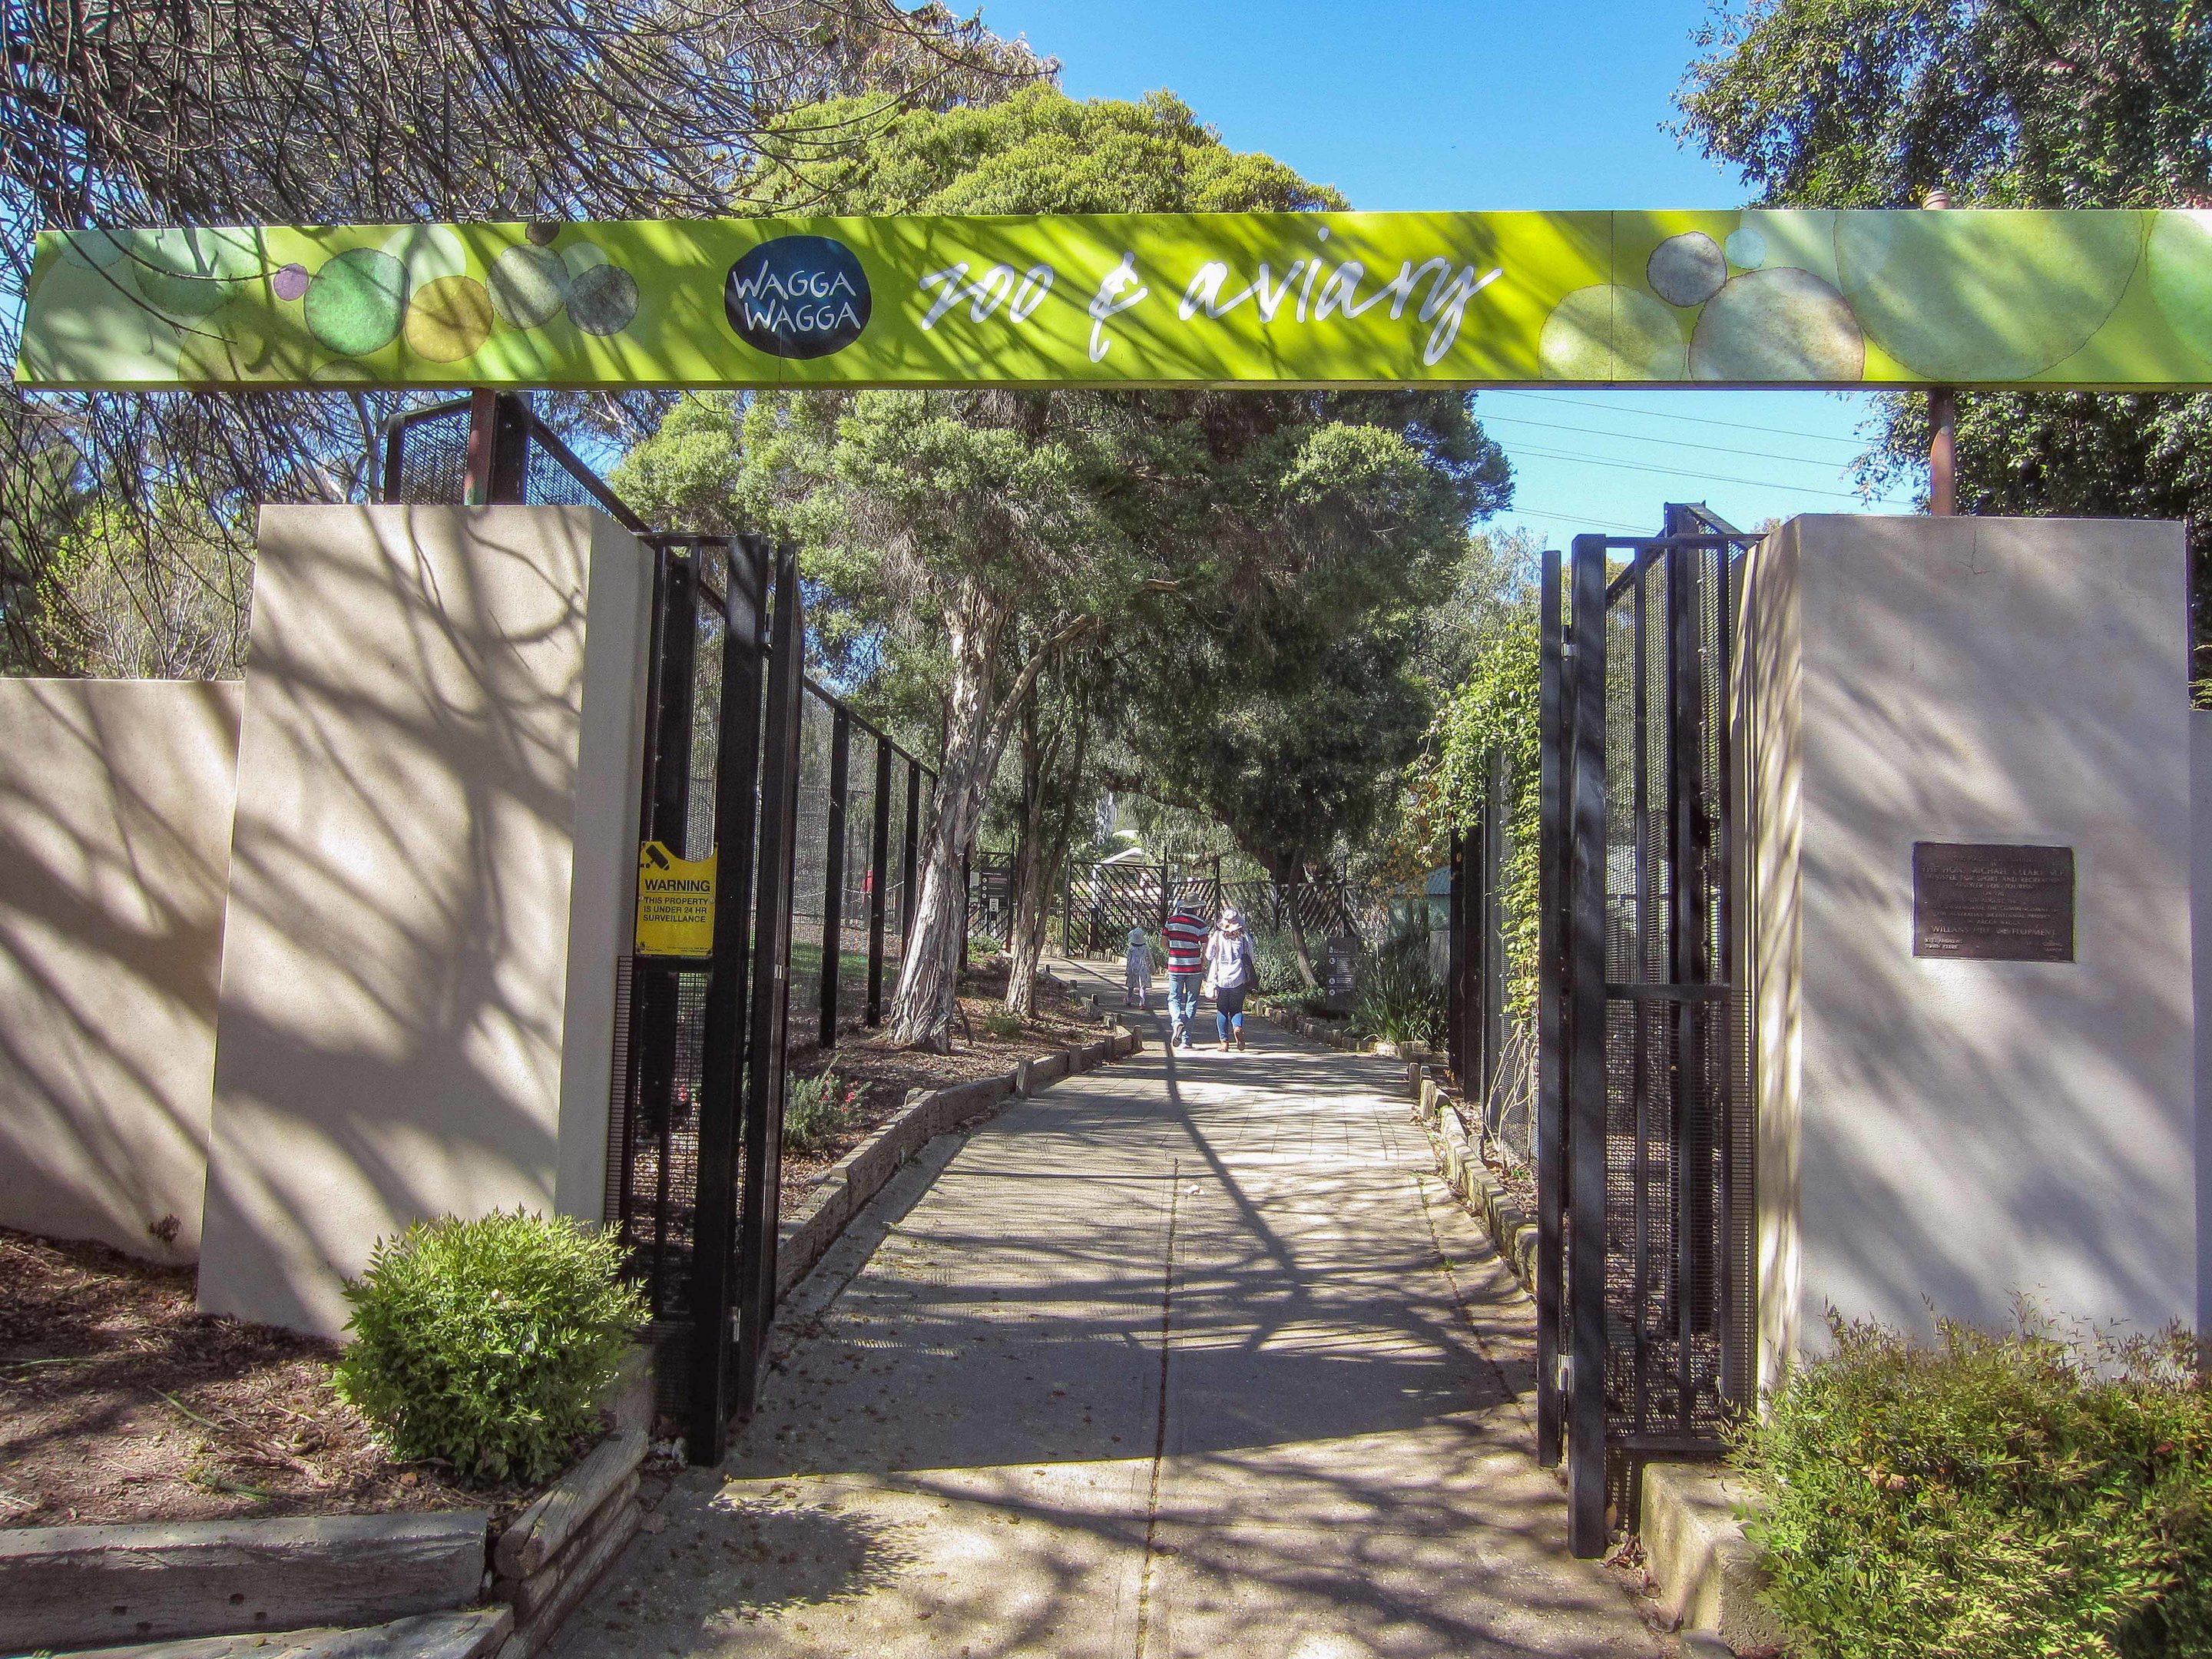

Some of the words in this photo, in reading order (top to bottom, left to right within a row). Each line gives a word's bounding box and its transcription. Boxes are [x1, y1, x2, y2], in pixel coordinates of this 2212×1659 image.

[732, 259, 856, 301] WAGGA
[919, 262, 1054, 331] zoo
[1089, 251, 1149, 363] &
[1178, 227, 1504, 366] aviary
[743, 300, 862, 333] WAGGA
[644, 879, 710, 892] WARNING
[643, 914, 707, 922] SURVEILLANCE
